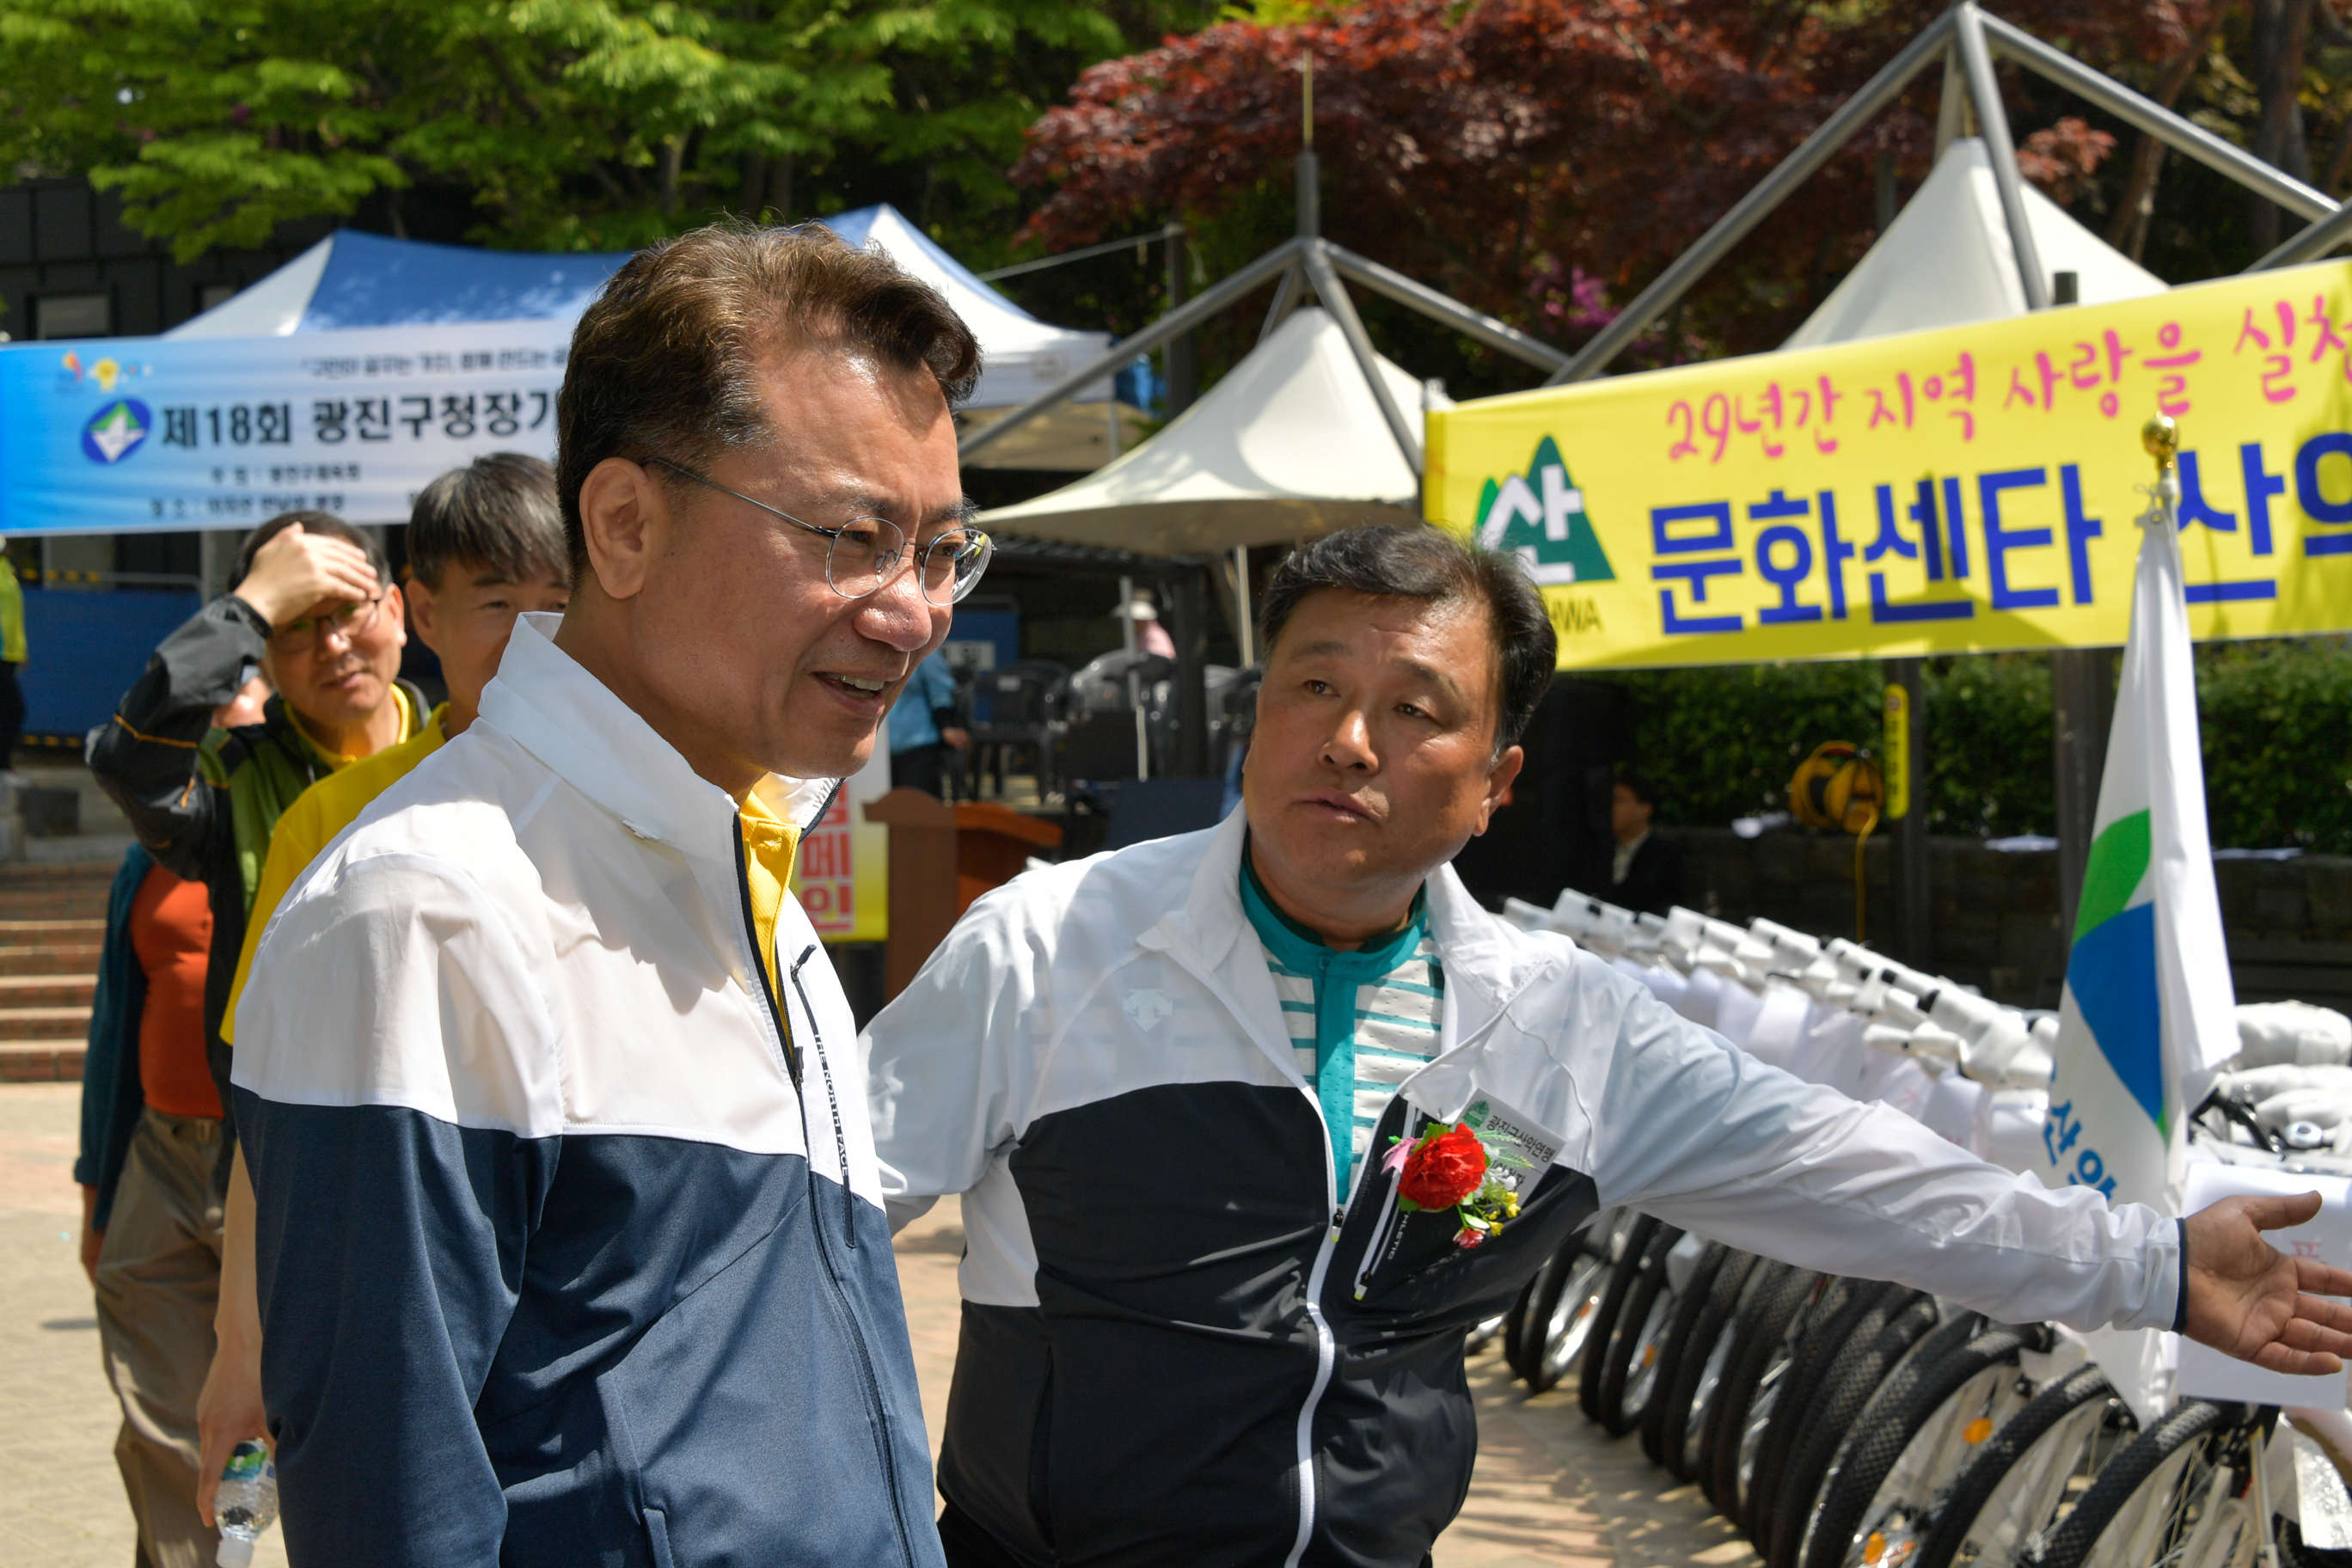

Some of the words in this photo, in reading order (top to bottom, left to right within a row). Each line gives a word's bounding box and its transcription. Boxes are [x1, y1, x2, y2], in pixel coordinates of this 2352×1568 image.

[162, 401, 291, 448] 제18회
[1666, 375, 1843, 463] 29년간
[1864, 351, 1976, 441] 지역
[2003, 322, 2202, 418] 사랑을
[1476, 463, 1583, 585] 산
[1649, 462, 2104, 635] 문화센타
[814, 1033, 827, 1063] THE
[823, 1069, 842, 1128] NORTH
[836, 1133, 849, 1177] FACE
[1387, 1210, 1411, 1260] HLETIC
